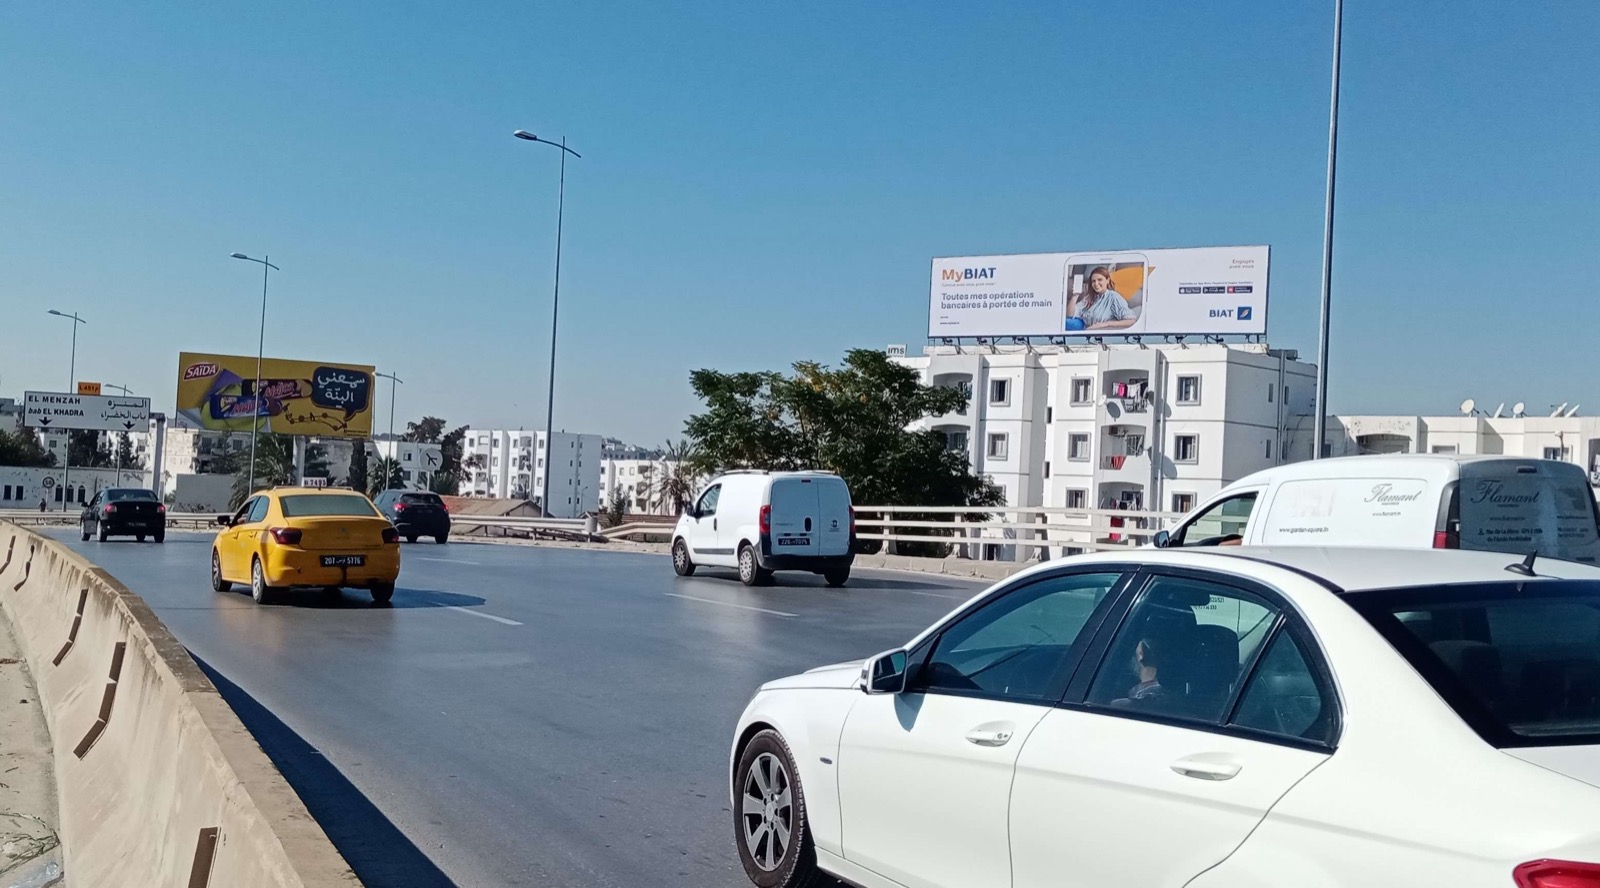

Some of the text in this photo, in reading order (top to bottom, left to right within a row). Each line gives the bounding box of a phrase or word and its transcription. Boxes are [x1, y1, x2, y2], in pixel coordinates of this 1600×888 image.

[942, 267, 997, 282] MyBIAT
[941, 292, 969, 300] Toutes
[989, 291, 1034, 301] opérations
[941, 299, 1052, 310] bancaires à portée de main
[1209, 309, 1233, 318] BIAT
[186, 365, 216, 379] SAÏDA
[42, 396, 80, 405] MENZAH
[107, 399, 147, 410] المنزه
[101, 410, 146, 421] باب الخضراء
[1470, 480, 1540, 503] Flamant
